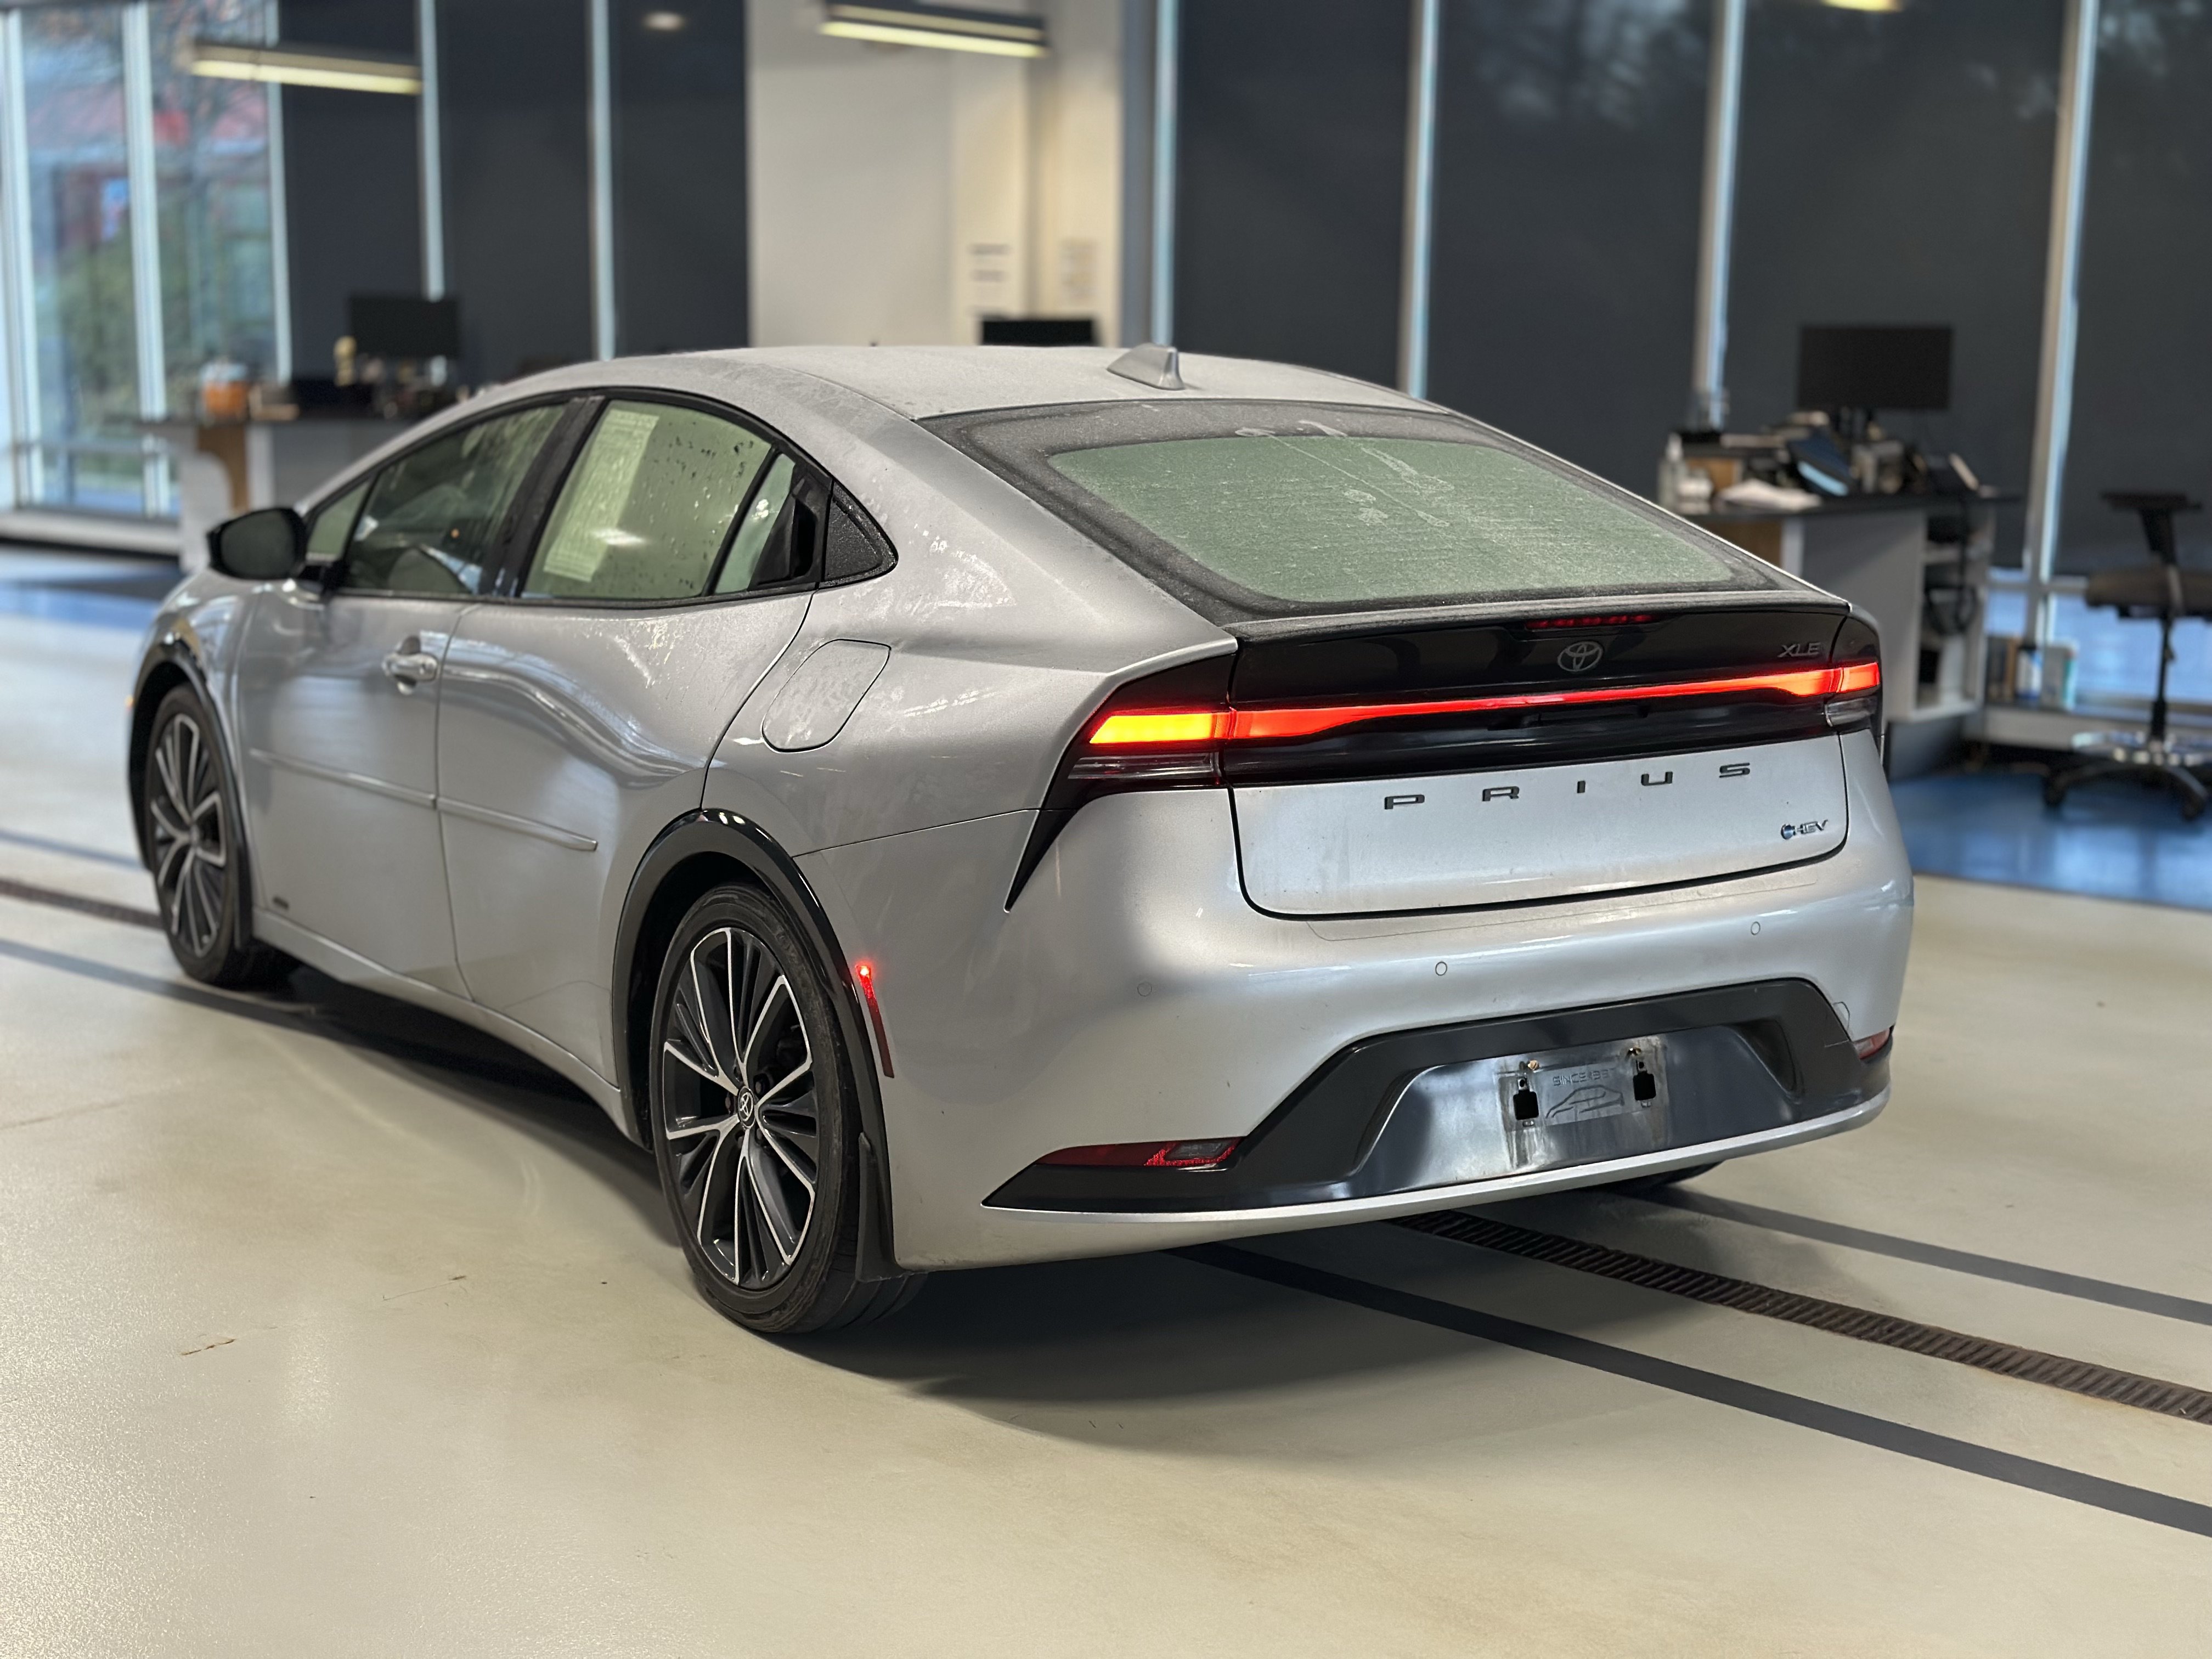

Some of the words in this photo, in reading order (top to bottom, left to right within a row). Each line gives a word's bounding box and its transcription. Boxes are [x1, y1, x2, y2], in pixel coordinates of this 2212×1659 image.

[1778, 642, 1821, 658] XLE
[1384, 763, 1750, 810] PRIUS
[1791, 819, 1829, 836] HEV
[1552, 1071, 1587, 1087] SINCE
